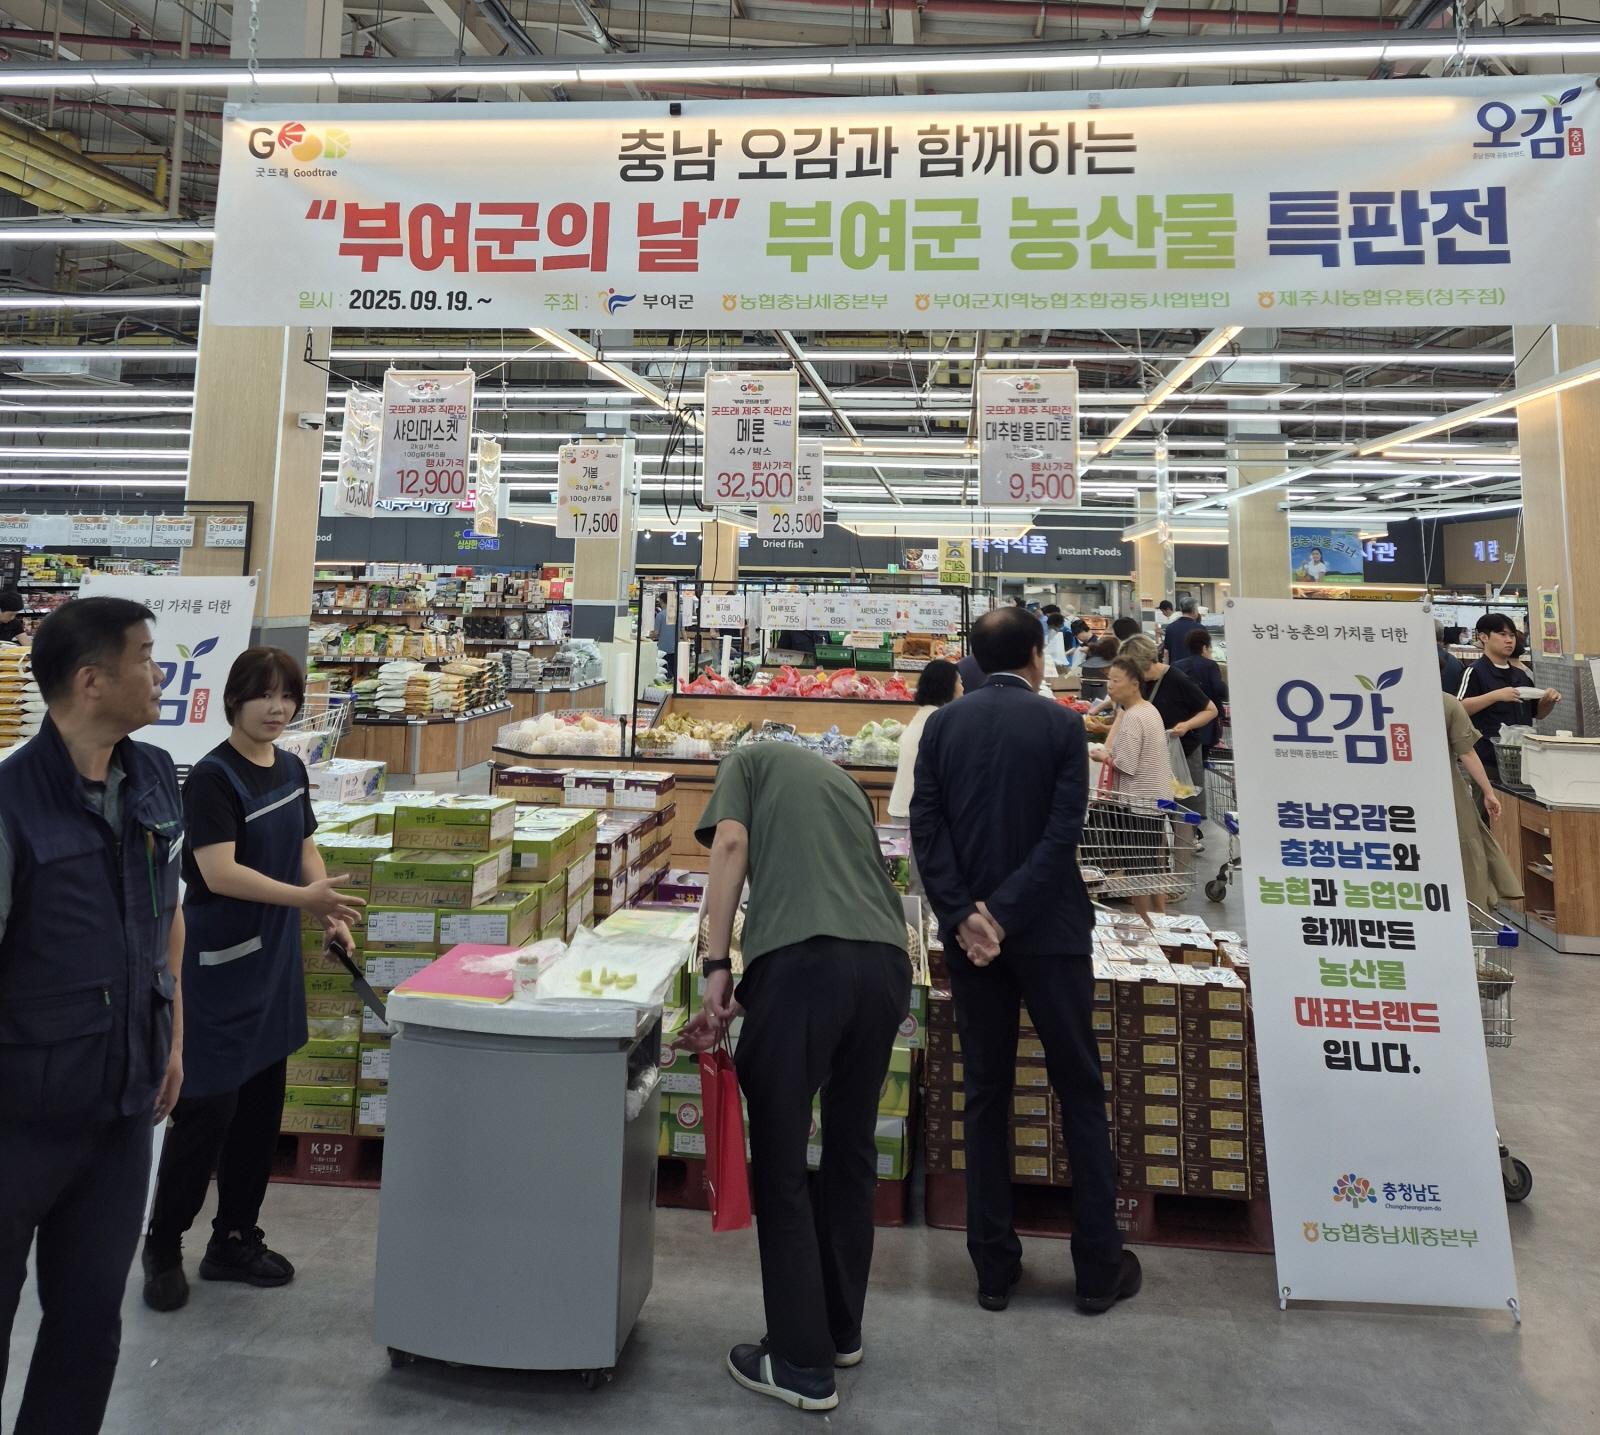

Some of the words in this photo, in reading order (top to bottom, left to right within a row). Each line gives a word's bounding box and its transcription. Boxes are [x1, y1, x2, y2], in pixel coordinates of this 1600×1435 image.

[1473, 102, 1573, 159] 오감
[1570, 129, 1582, 153] 충남
[617, 128, 723, 182] 충남
[738, 125, 899, 180] 오감과
[917, 121, 1137, 178] 함께하는
[256, 167, 288, 178] 굿뜨래
[294, 168, 337, 178] Goodtrae
[305, 199, 610, 272] “부여군의
[637, 198, 740, 272] 날”
[766, 198, 982, 273] 부여군
[1008, 193, 1238, 271] 농산물
[1267, 186, 1511, 268] 특판전
[642, 293, 694, 311] 부여군
[740, 293, 888, 310] 농협충남세종본부
[933, 291, 1230, 310] 부여군지역농협조합공동사업법인
[1278, 287, 1506, 307] 제주시농협유통(청주점)
[389, 405, 415, 414] 굿뜨래
[418, 405, 436, 414] 제주
[439, 405, 466, 415] 직판전
[711, 406, 739, 416] 굿뜨래
[742, 406, 761, 416] 제주
[763, 406, 792, 416] 직판전
[985, 405, 1015, 415] 굿뜨래
[1018, 405, 1038, 415] 제주
[1041, 405, 1072, 415] 직판전
[393, 419, 459, 442] 샤인머스켓
[737, 418, 766, 442] 메론
[985, 421, 1072, 441] 대추방울토마토
[410, 443, 440, 451] 2kg/박스
[581, 449, 599, 460] 과일
[425, 459, 464, 467] 행사가격
[582, 466, 598, 479] 거봉
[752, 461, 792, 470] 행사가격
[1031, 462, 1074, 471] 행사가격
[396, 469, 465, 497] 12,900
[717, 472, 793, 500] 32,500
[1009, 473, 1076, 502] 9,500
[573, 513, 618, 534] 17,500
[772, 513, 821, 535] 23,500
[763, 540, 786, 548] Dried
[788, 540, 804, 548] fish
[1058, 546, 1091, 555] Instant
[1093, 547, 1122, 556] Foods
[1474, 540, 1499, 562] 계란
[167, 600, 203, 614] 가치를
[208, 600, 232, 614] 더한
[721, 614, 741, 623] 9,800
[830, 617, 846, 625] 895
[875, 617, 892, 625] 885
[932, 619, 949, 627] 880
[1251, 623, 1330, 641] 농업·농촌의
[1334, 626, 1376, 643] 가치를
[1381, 627, 1409, 643] 더한
[192, 690, 206, 720] 충남
[1273, 679, 1394, 764] 오감
[1393, 726, 1408, 757] 충남
[1274, 749, 1289, 758] 충남
[1289, 749, 1303, 758] 원예
[1304, 750, 1340, 759] 공동브랜드
[1277, 801, 1417, 833] 충남오감은
[398, 834, 485, 847] PREMIUM
[1280, 839, 1421, 871] 충청남도와
[374, 890, 467, 905] PREMIUM
[1258, 876, 1338, 907] 농협과
[1343, 879, 1450, 912] 농업인이
[1301, 916, 1416, 950] 함께만든
[1318, 957, 1407, 990] 농산물
[1294, 996, 1441, 1033] 대표브랜드
[1323, 1039, 1421, 1075] 입니다.
[310, 1142, 343, 1155] KPP
[1382, 1182, 1442, 1202] 충청남도
[1384, 1203, 1442, 1212] Chungcheongnam-do
[1322, 1223, 1479, 1248] 농협충남세종본부
